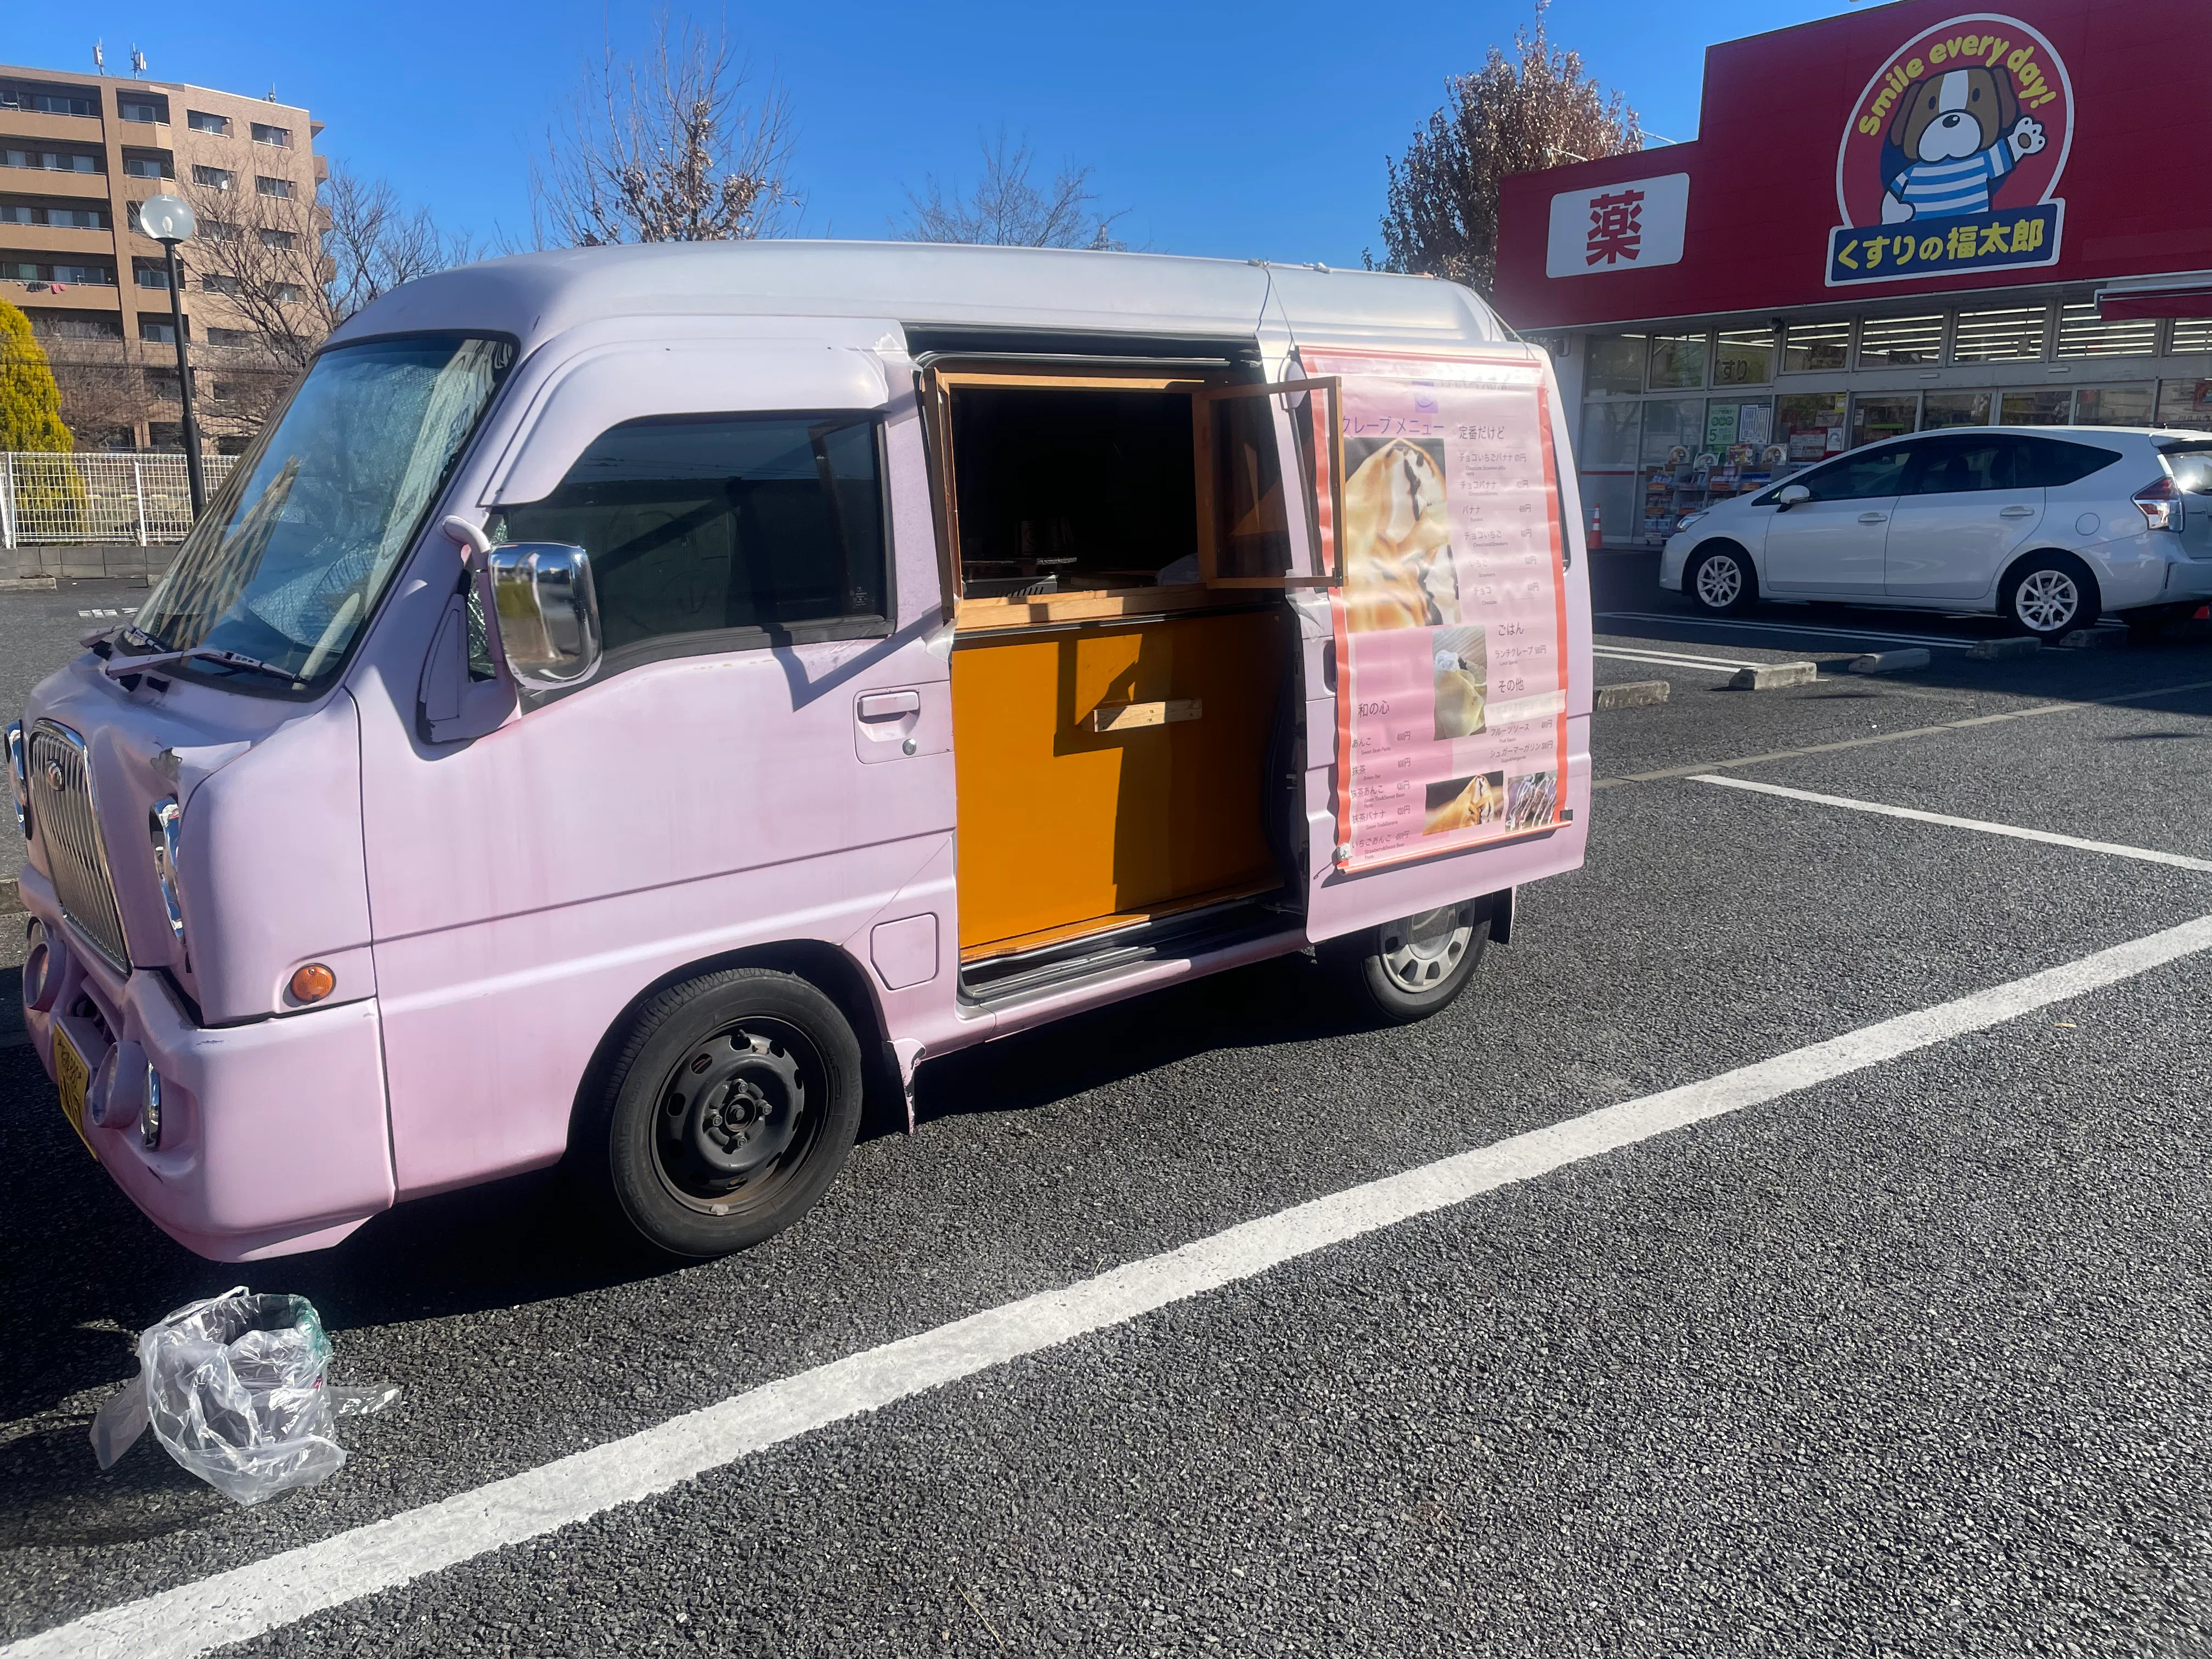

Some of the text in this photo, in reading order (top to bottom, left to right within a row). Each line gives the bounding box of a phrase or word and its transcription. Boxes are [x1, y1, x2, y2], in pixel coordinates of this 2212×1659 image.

[1859, 35, 2057, 136] Smile every day!
[1585, 189, 1645, 266] 薬
[1838, 218, 2045, 269] くすりの福太郎
[1396, 417, 1444, 435] メニュー
[1459, 425, 1505, 439] 定番だけど
[1459, 453, 1513, 462] チョコいちごバナナ
[1460, 481, 1497, 489] チョコバナナ
[1462, 505, 1481, 514] バナナ
[1474, 586, 1492, 595] チョコ
[1498, 622, 1524, 636] ごはん
[1494, 646, 1533, 659] ランチクレープ
[1498, 677, 1524, 692] その他
[1358, 700, 1390, 718] 和の心
[1490, 723, 1530, 737] フルーツソース
[1352, 737, 1372, 748] あんこ
[1489, 743, 1542, 759] シュガーマーガリン
[1352, 765, 1366, 776] 抹茶
[1351, 785, 1384, 799] 抹茶あんこ
[1352, 809, 1386, 825] 抹茶バナナ
[1352, 834, 1392, 849] いちごあんこ
